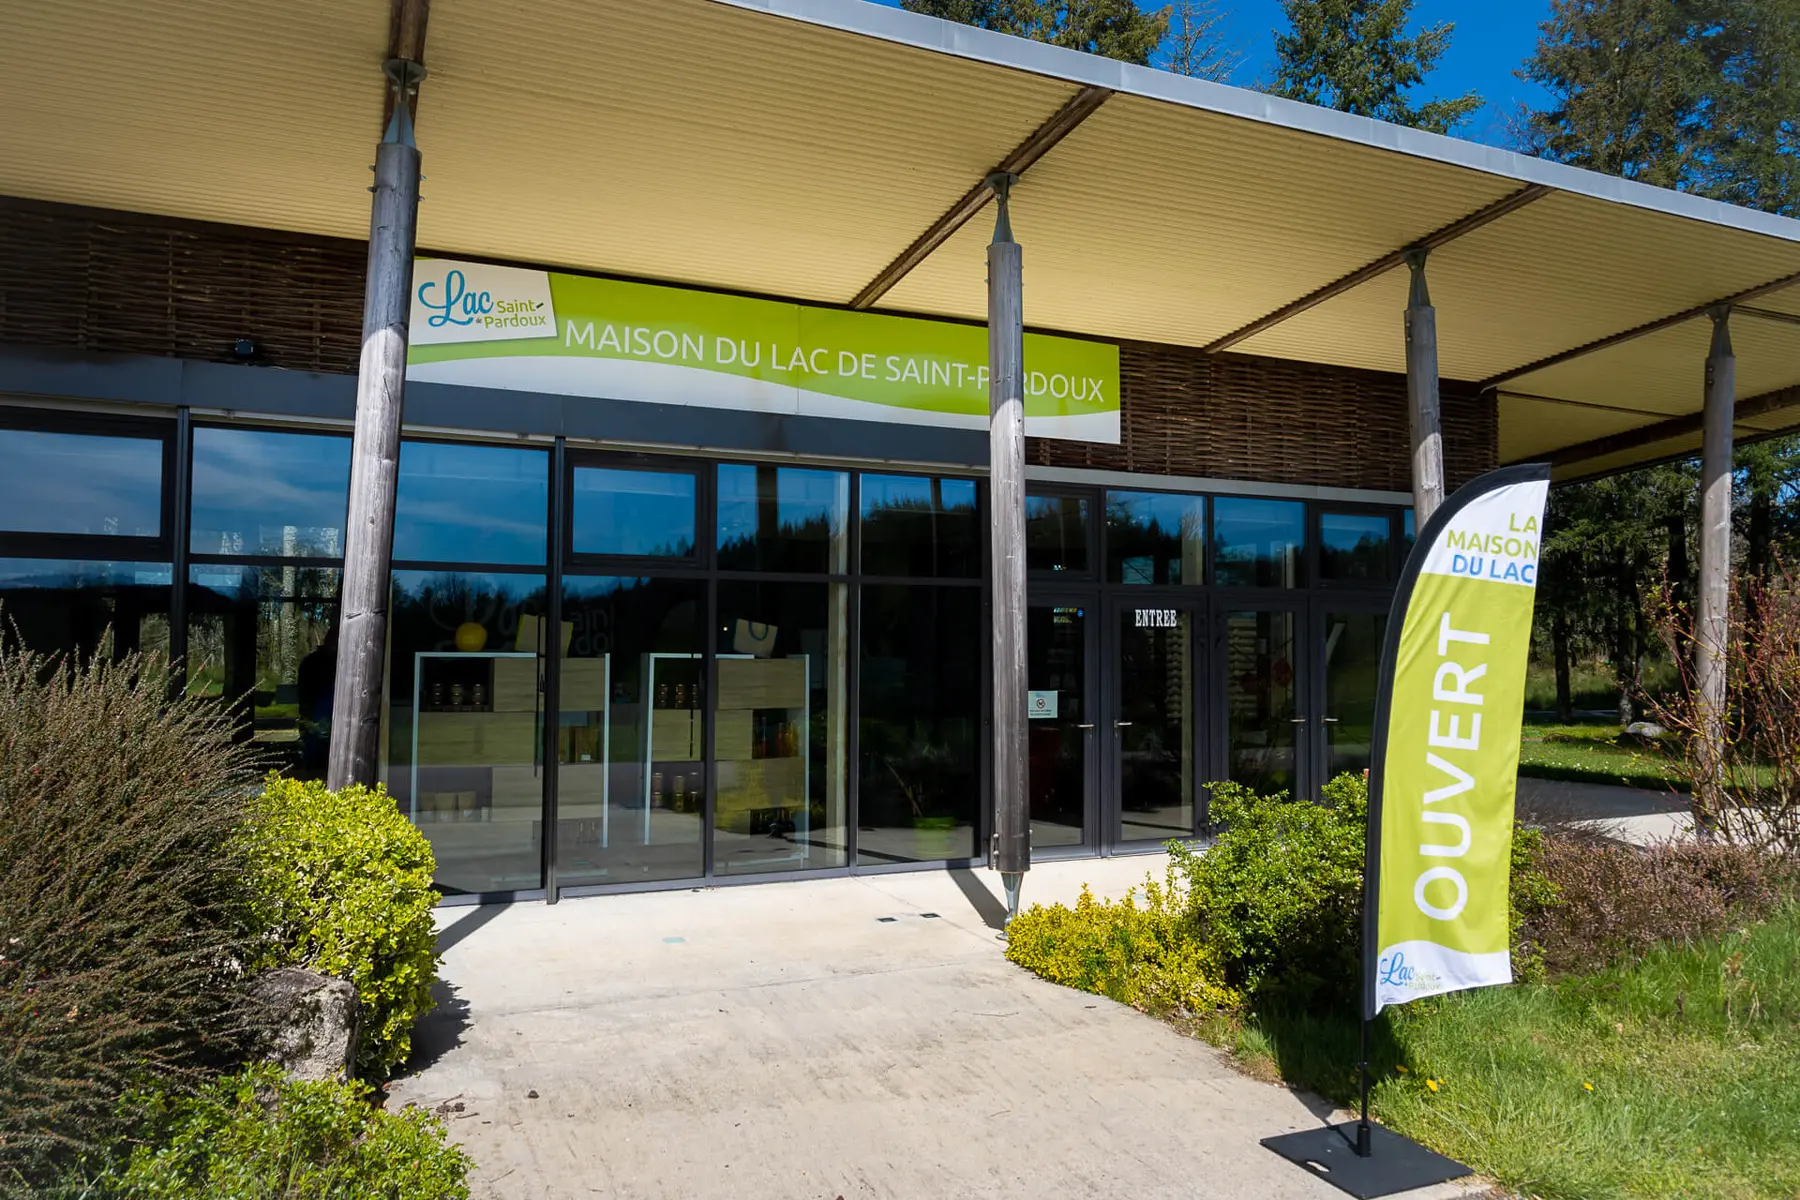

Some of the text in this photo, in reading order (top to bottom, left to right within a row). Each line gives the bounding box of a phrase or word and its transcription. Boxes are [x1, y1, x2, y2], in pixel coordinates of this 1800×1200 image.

[418, 270, 494, 327] Lac
[484, 313, 547, 329] Pardoux
[565, 319, 1104, 402] MAISON DU LAC DE SAINT-PDOUX
[1509, 512, 1538, 535] LA
[1446, 529, 1539, 560] MAISON
[1451, 554, 1536, 584] DU LAC
[1134, 608, 1177, 628] ENTREE
[1413, 611, 1491, 921] OUVERT
[1379, 952, 1415, 986] Lac
